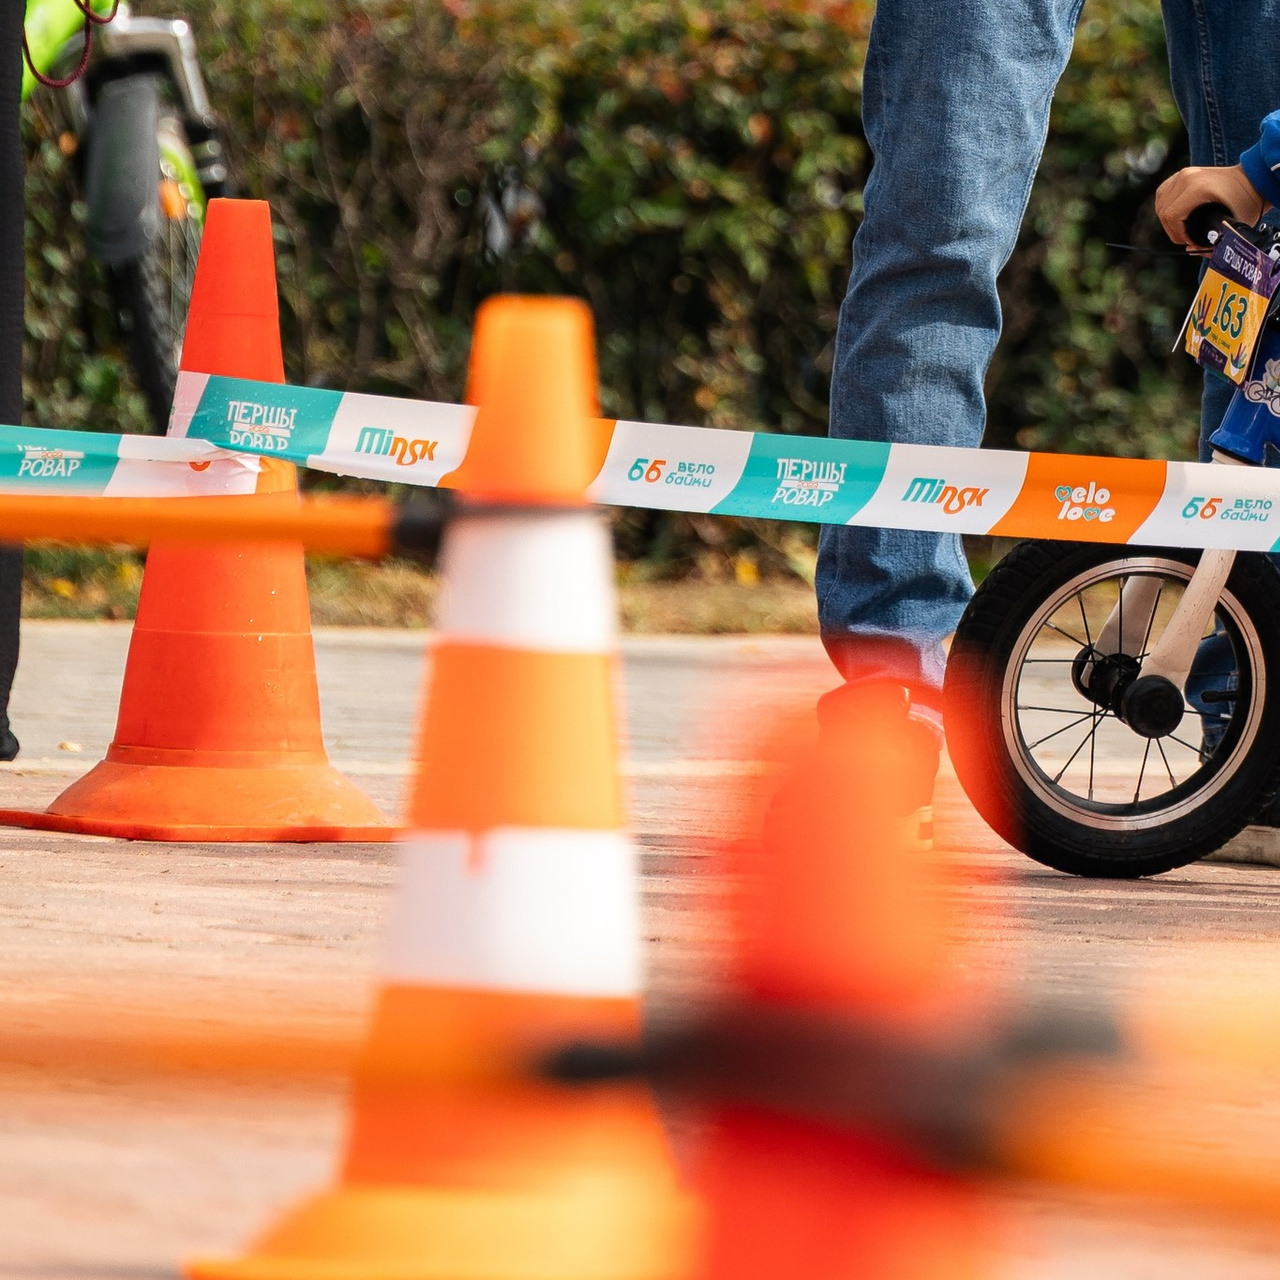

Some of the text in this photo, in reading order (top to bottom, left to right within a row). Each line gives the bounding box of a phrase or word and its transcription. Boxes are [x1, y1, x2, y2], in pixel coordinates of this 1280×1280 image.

[1212, 282, 1248, 339] 163
[227, 400, 297, 429] ПЕРШЫ
[18, 459, 80, 477] РОВАР
[777, 458, 847, 484] ПЕРШЫ
[665, 472, 712, 488] байки
[771, 488, 833, 507] РОВАР
[1221, 508, 1269, 522] байки
